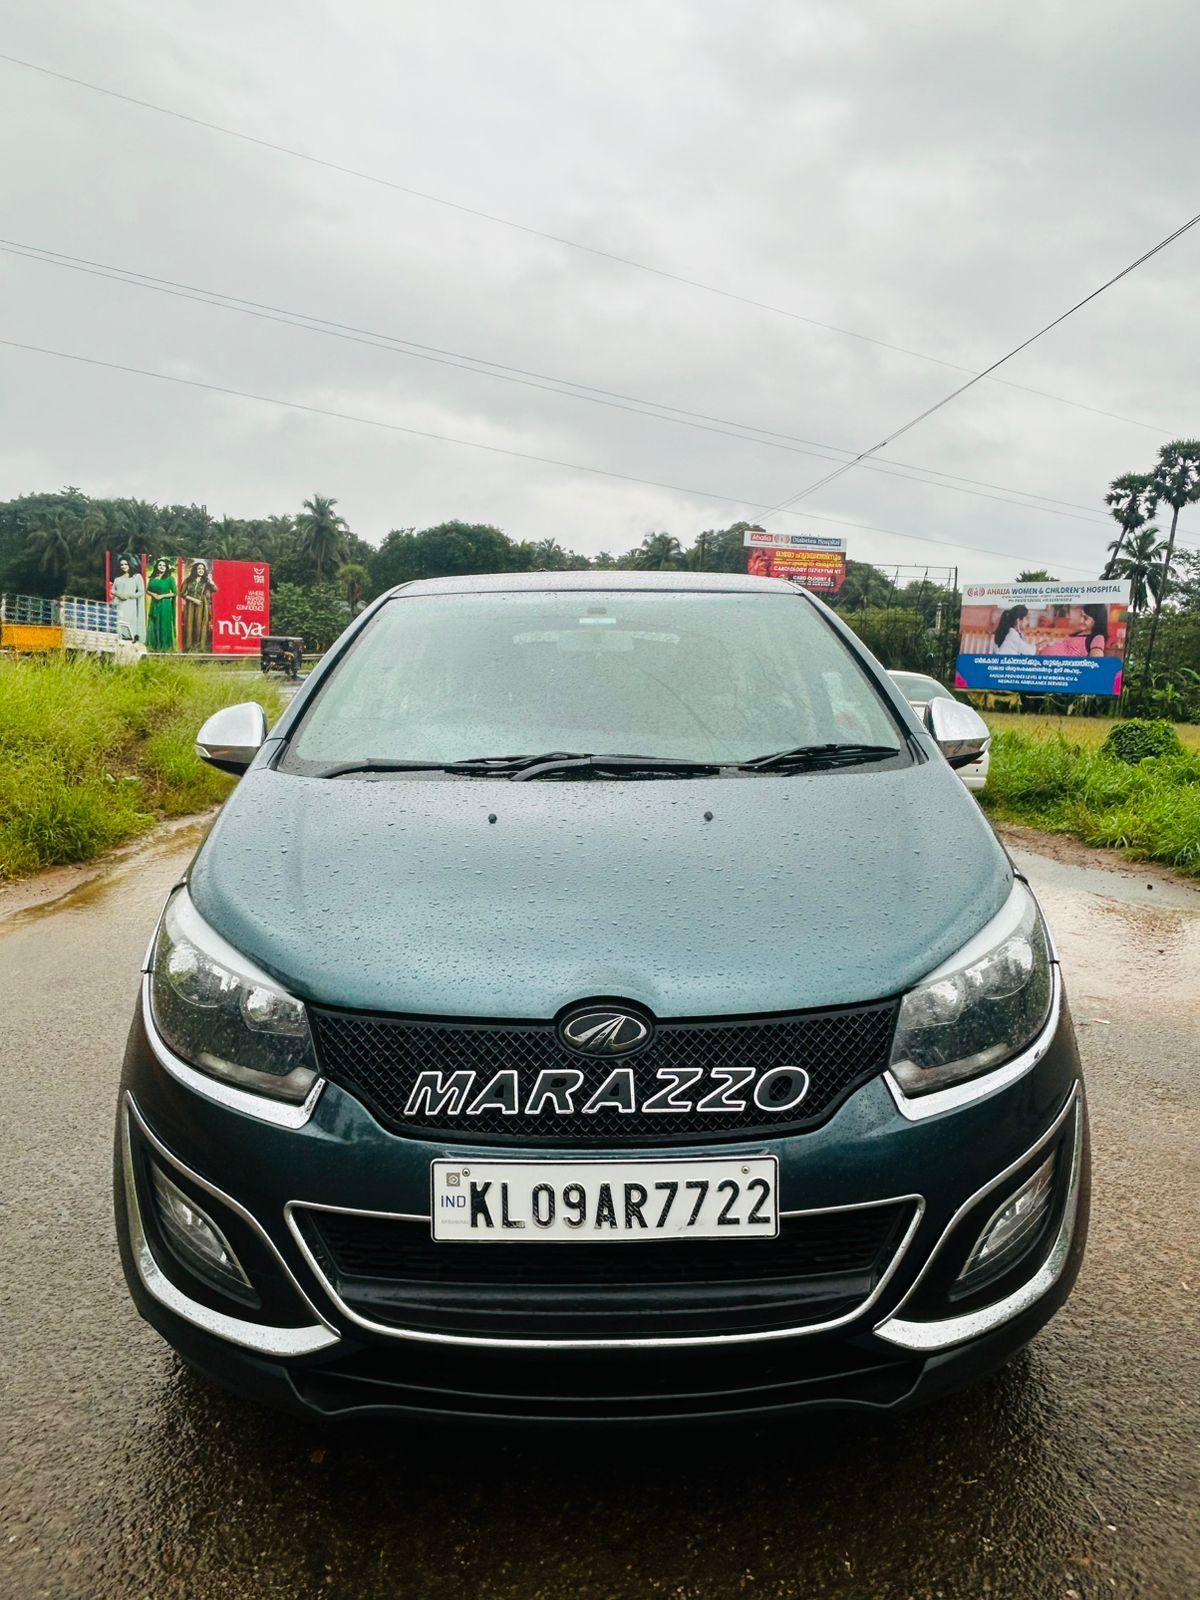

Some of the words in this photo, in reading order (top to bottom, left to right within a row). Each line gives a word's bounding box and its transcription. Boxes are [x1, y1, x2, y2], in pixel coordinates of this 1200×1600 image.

[1045, 586, 1085, 594] CHILDREN'S
[1086, 585, 1121, 594] HOSPITAL
[218, 615, 266, 640] niya
[404, 1066, 810, 1115] MARAZZO
[440, 1195, 466, 1208] IND
[469, 1178, 771, 1229] KL09AR7722
